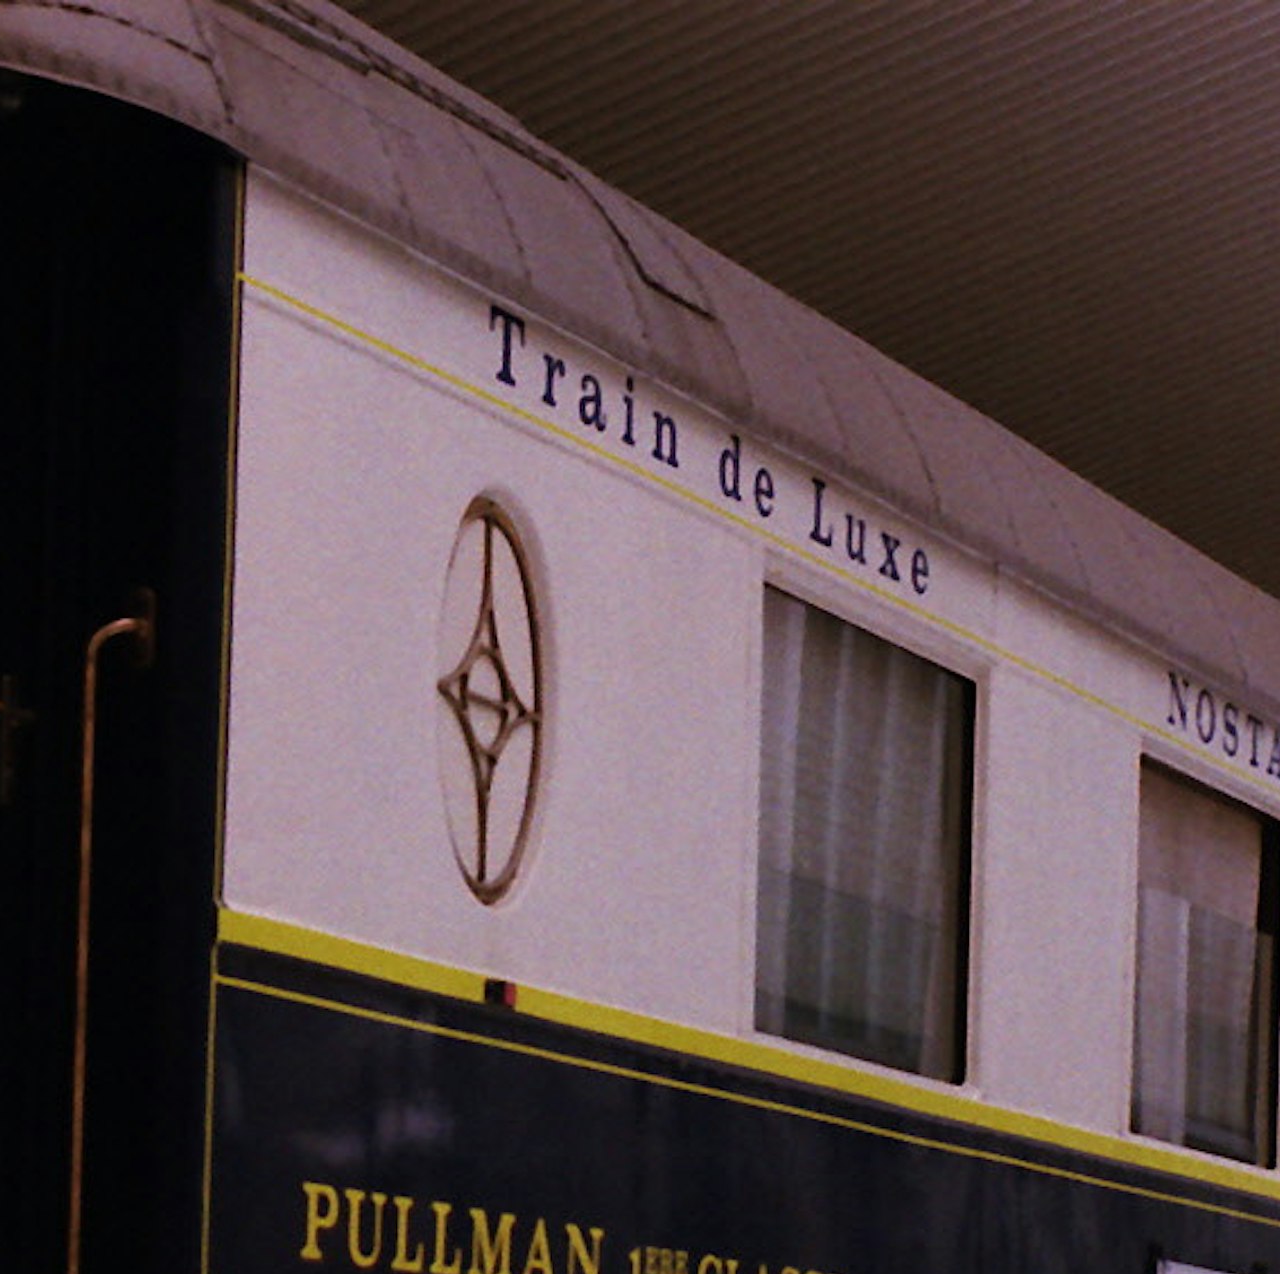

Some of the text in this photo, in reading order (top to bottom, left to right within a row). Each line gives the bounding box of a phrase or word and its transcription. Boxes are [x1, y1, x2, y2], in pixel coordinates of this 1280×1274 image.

[489, 304, 931, 595] Train de Luxe
